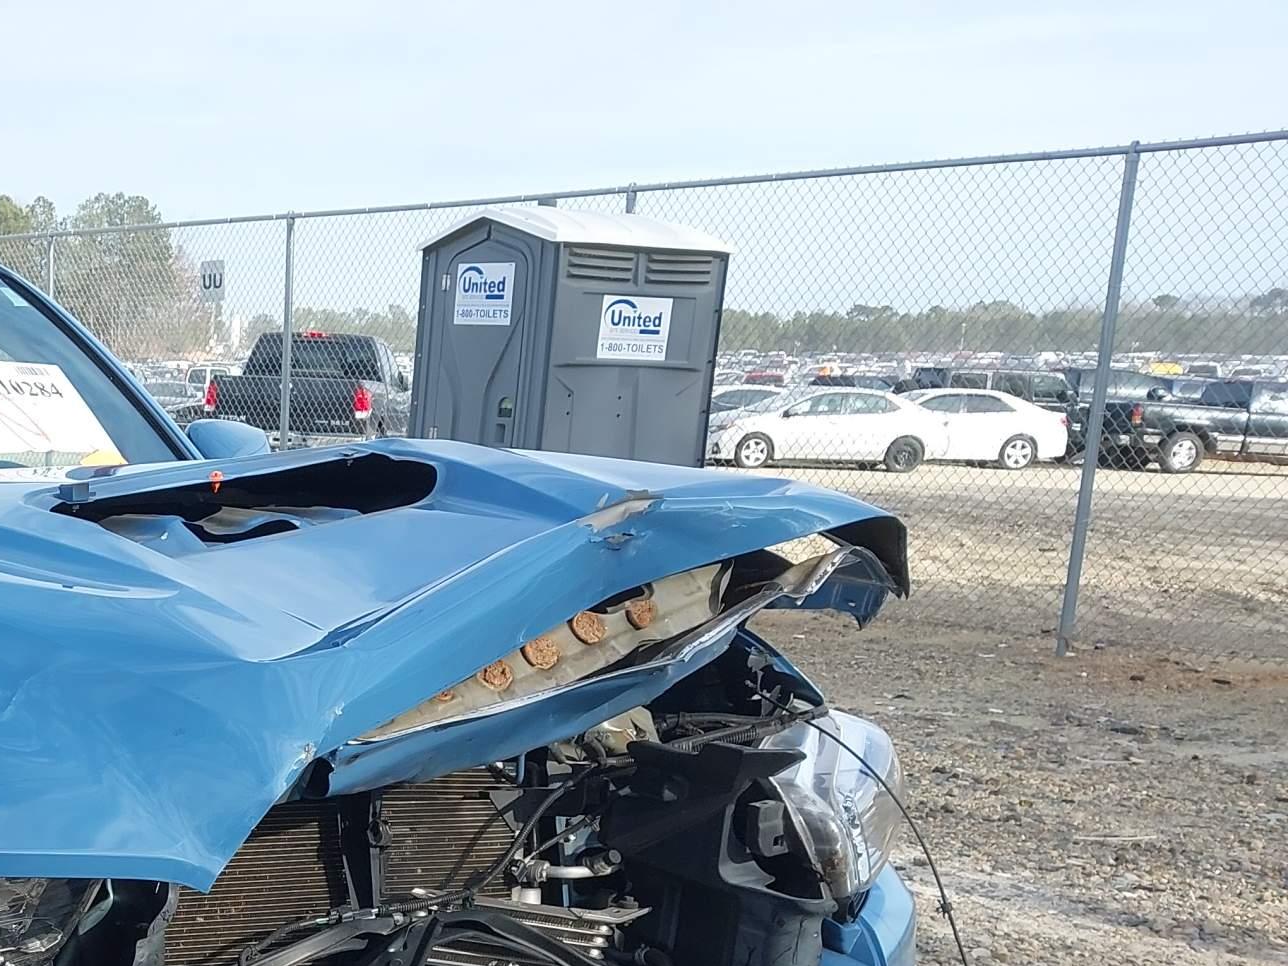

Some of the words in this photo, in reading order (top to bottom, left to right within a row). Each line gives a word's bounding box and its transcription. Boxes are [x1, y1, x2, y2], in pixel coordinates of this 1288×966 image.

[463, 275, 506, 294] United
[456, 308, 509, 319] 1-800-TOILETS
[611, 309, 663, 328] United
[600, 342, 665, 354] 1-800-TOILETS
